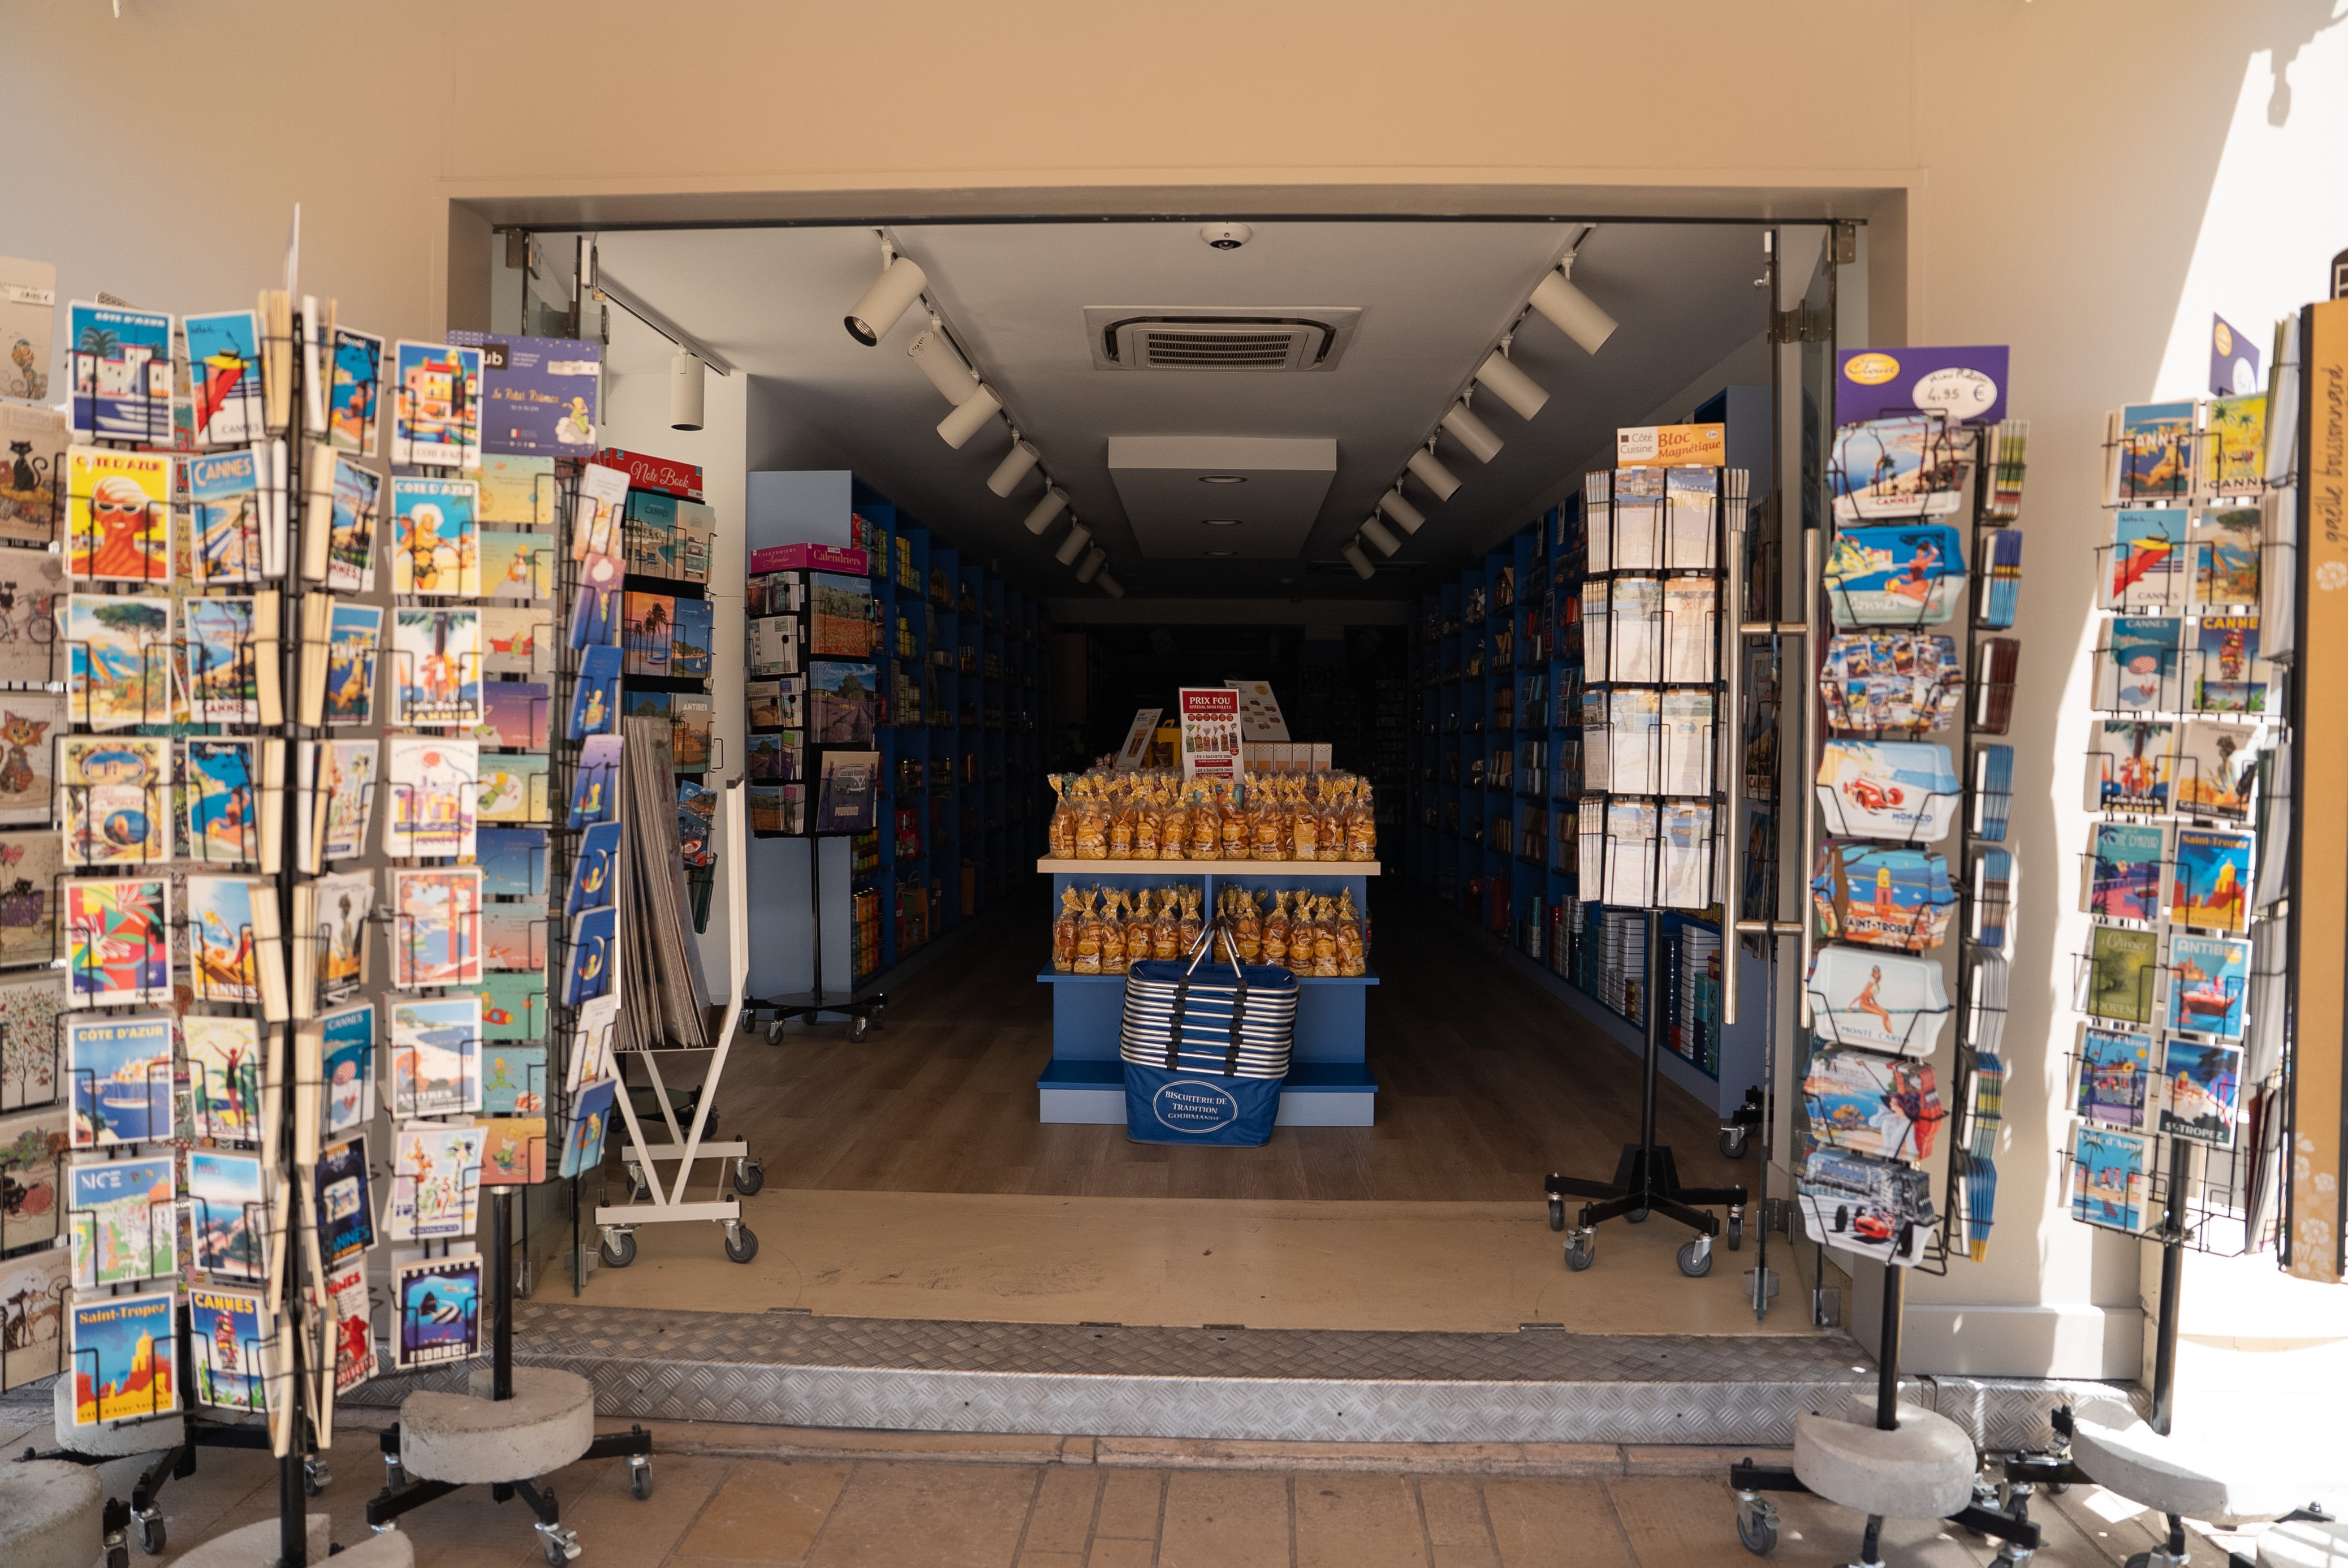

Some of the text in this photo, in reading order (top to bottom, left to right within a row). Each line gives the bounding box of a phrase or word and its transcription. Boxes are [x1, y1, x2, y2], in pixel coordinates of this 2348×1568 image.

[1631, 432, 1654, 443] Côté
[1658, 432, 1691, 448] Bloc
[1620, 440, 1722, 460] Cuisine Magnétique
[194, 457, 252, 487] CANNES
[629, 460, 690, 490] Note Book
[1876, 495, 1917, 506] CANNES
[813, 548, 862, 567] Calendriers
[2137, 591, 2179, 601] CANNS
[2125, 619, 2169, 629] CANNES
[683, 702, 708, 711] ANTIBES
[79, 1026, 165, 1042] CÔTE D'AZUR
[1165, 1091, 1215, 1104] BISCUITERIE
[1172, 1103, 1218, 1115] TRADITION
[194, 1293, 254, 1314] CANNES
[79, 1303, 167, 1324] Saint-Tropez
